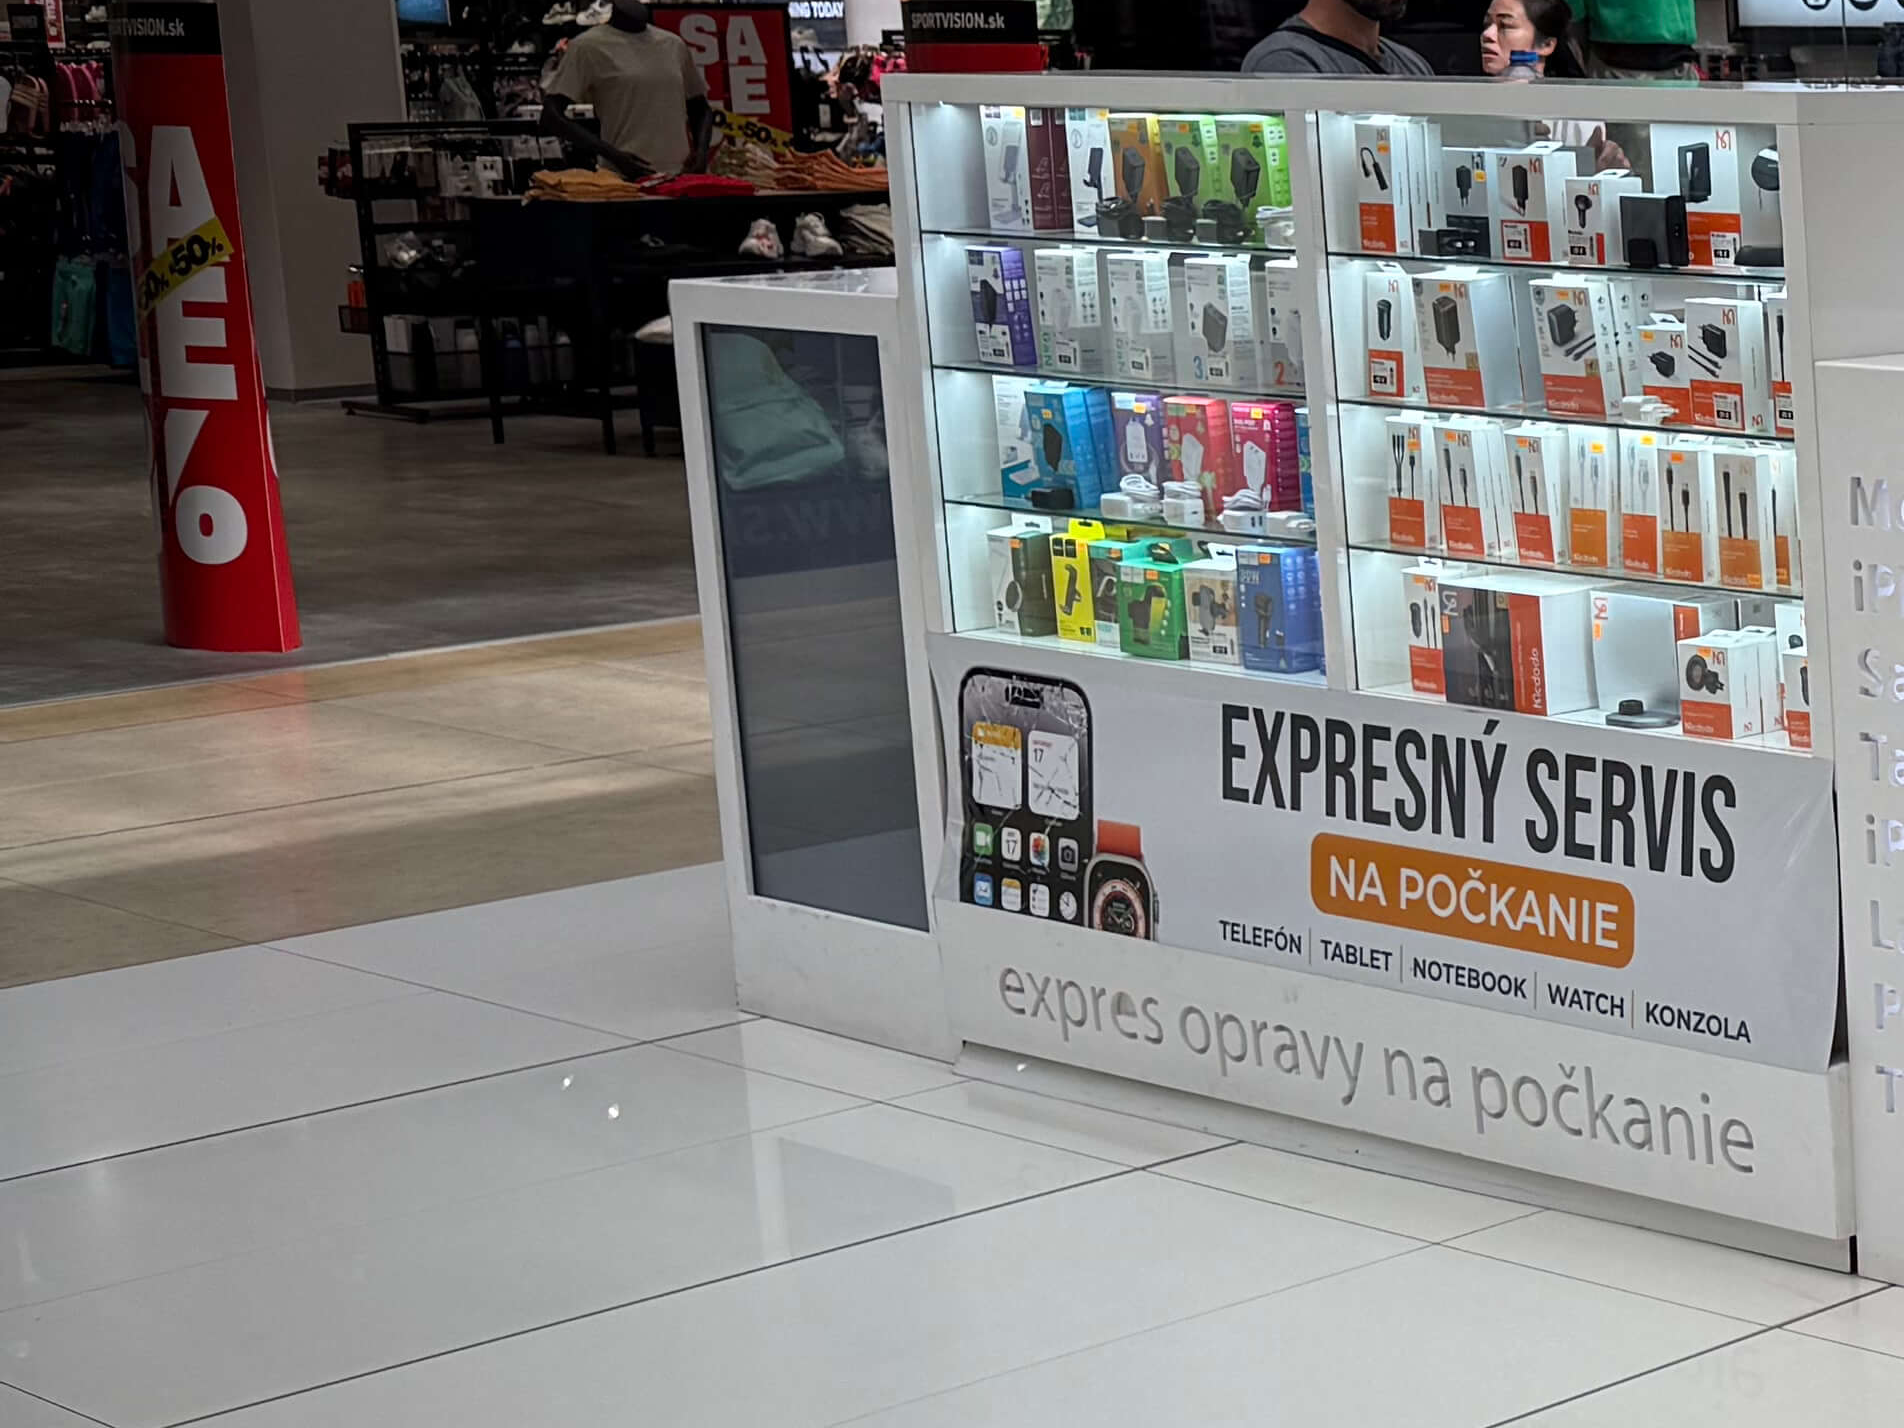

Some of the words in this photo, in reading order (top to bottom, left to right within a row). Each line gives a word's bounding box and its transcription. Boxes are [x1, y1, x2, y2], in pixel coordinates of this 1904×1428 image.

[911, 12, 1005, 30] SPORTVISION.sk
[1532, 648, 1542, 710] Mcdodo
[1220, 702, 1507, 845] EXPRESNÝ
[1524, 747, 1736, 883] SERVIS
[1328, 855, 1387, 907] NA
[1400, 867, 1620, 950] POČKANIE
[1218, 919, 1302, 955] TELEFÓN
[1320, 938, 1393, 972] TABLET
[1412, 956, 1528, 1000] NOTEBOOK
[1546, 982, 1625, 1019] WATCH
[1644, 1001, 1752, 1044] KONZOLA
[999, 966, 1164, 1045] expres
[1179, 1004, 1364, 1107] opravy
[1383, 1046, 1452, 1110] na
[1471, 1062, 1756, 1174] počkanie
